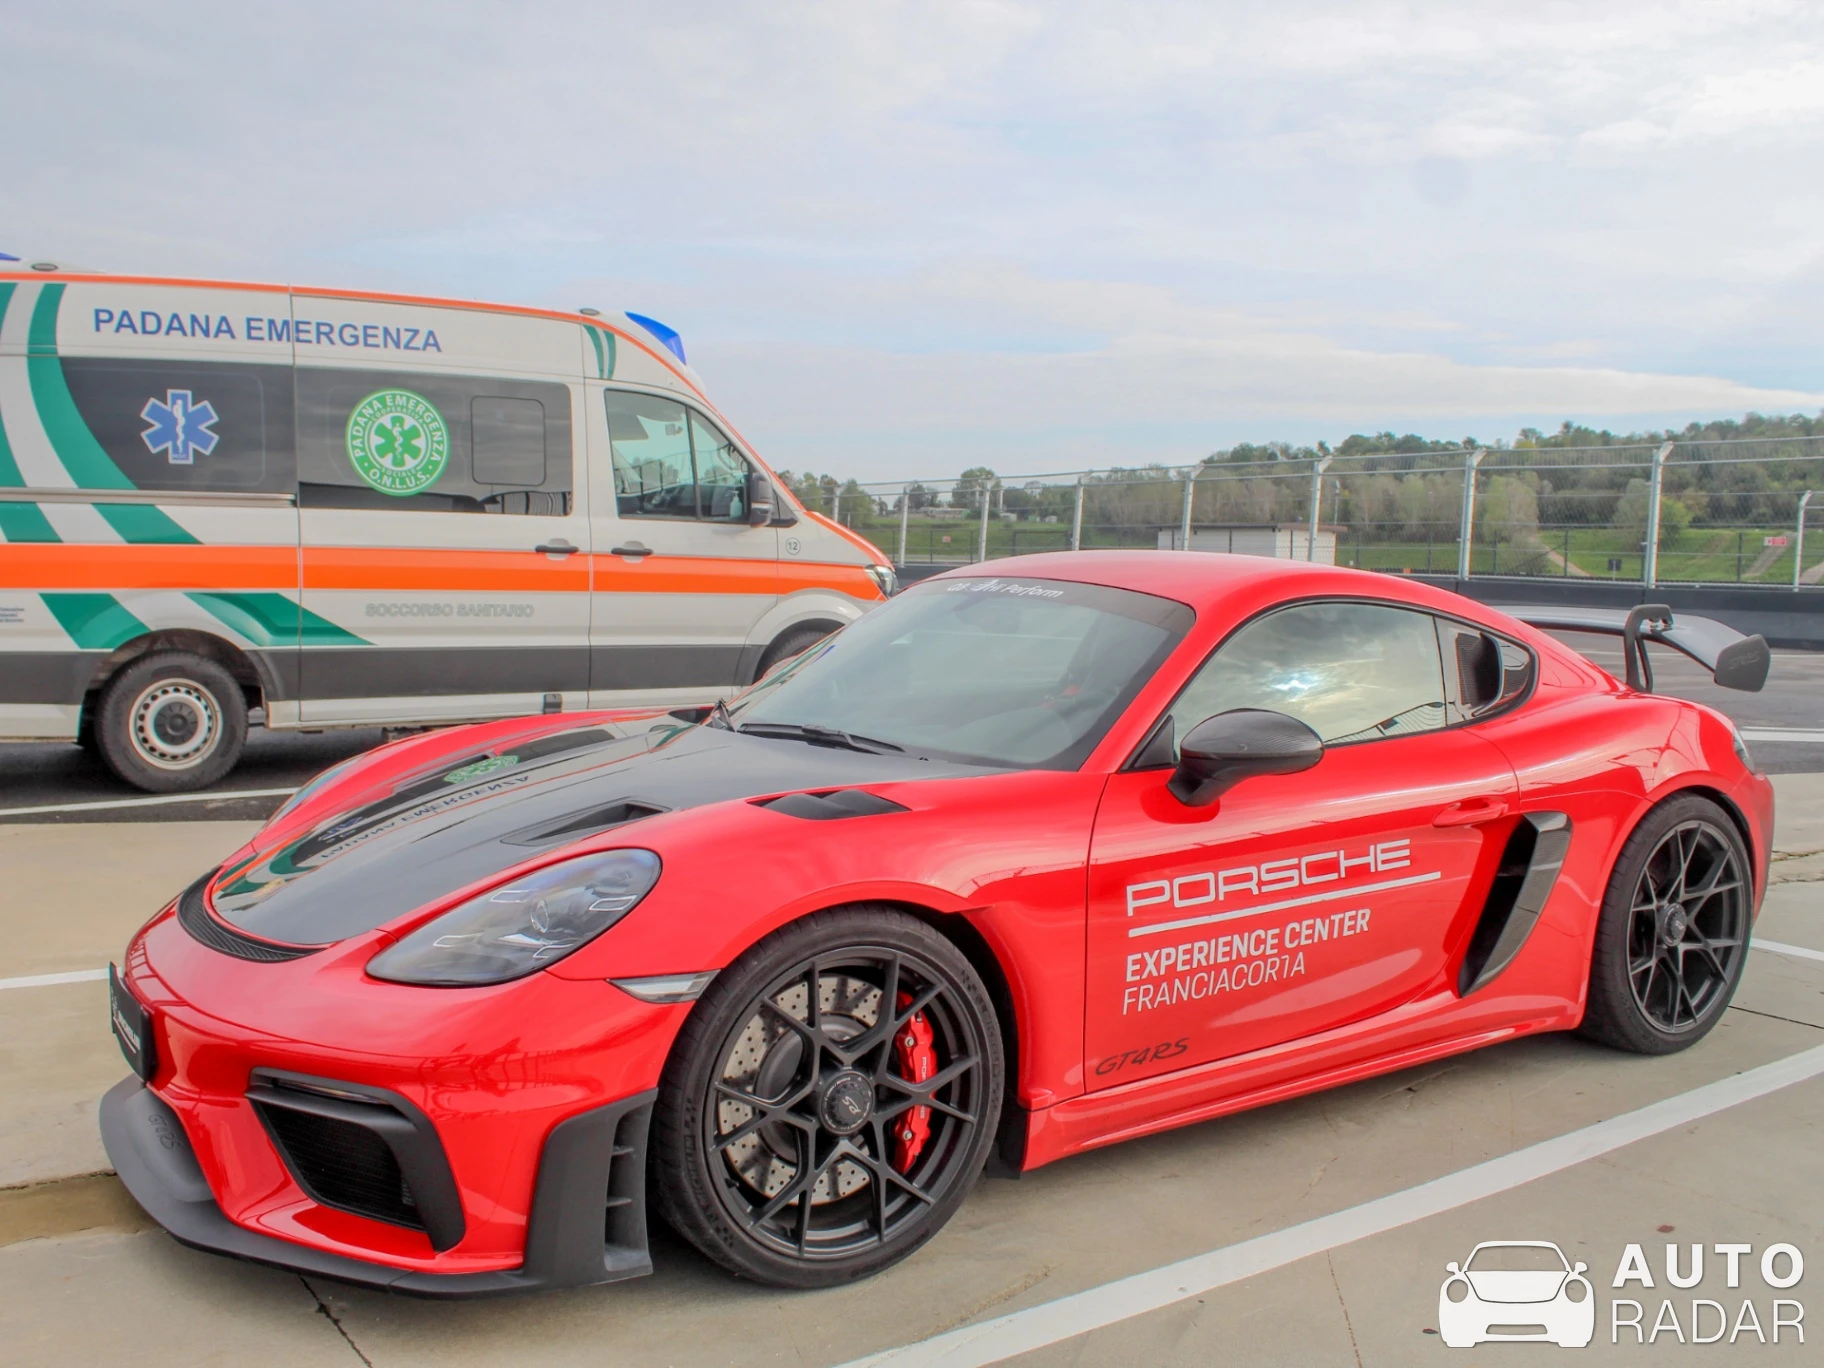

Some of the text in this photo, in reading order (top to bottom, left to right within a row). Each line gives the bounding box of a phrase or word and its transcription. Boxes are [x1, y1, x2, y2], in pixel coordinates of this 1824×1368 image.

[93, 308, 442, 352] PADANA EMERGENZA
[352, 395, 443, 461] PADANA EMERGENZA
[788, 541, 798, 550] 12
[365, 603, 535, 618] SOCCORSO SANITARIO
[1000, 583, 1065, 598] Perform
[1126, 838, 1411, 916] PORSCHE
[1125, 908, 1372, 983] EXPERIENCE CENTER
[1122, 951, 1306, 1016] FRANCIACORTA
